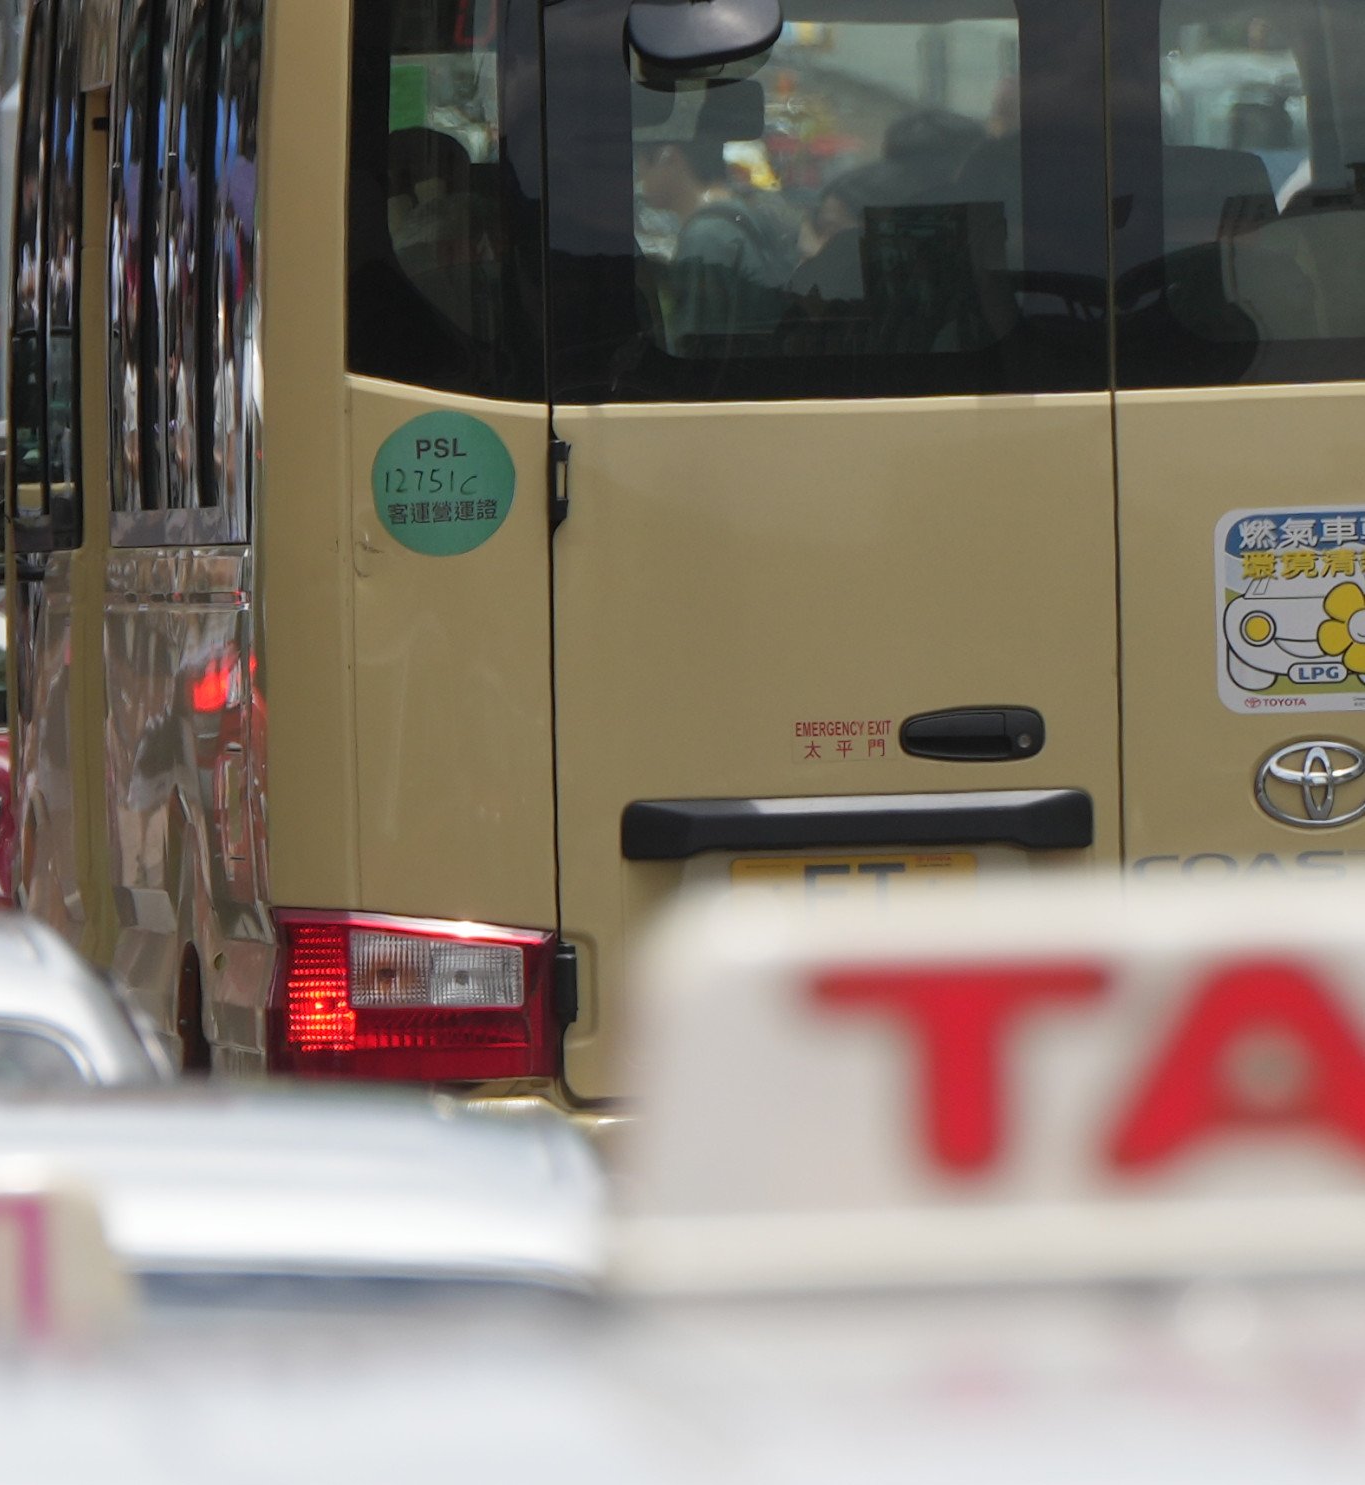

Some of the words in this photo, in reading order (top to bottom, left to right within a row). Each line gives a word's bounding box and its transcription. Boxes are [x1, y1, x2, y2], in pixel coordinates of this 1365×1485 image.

[415, 438, 467, 459] PSL
[387, 499, 499, 526] 客運營運證
[1238, 515, 1365, 549] 燃氣車
[1240, 549, 1365, 580] 環境清
[1297, 666, 1339, 681] LPG
[1263, 697, 1307, 708] TOYOTA
[795, 721, 865, 737] EMERGENCY
[867, 720, 892, 736] EXIT
